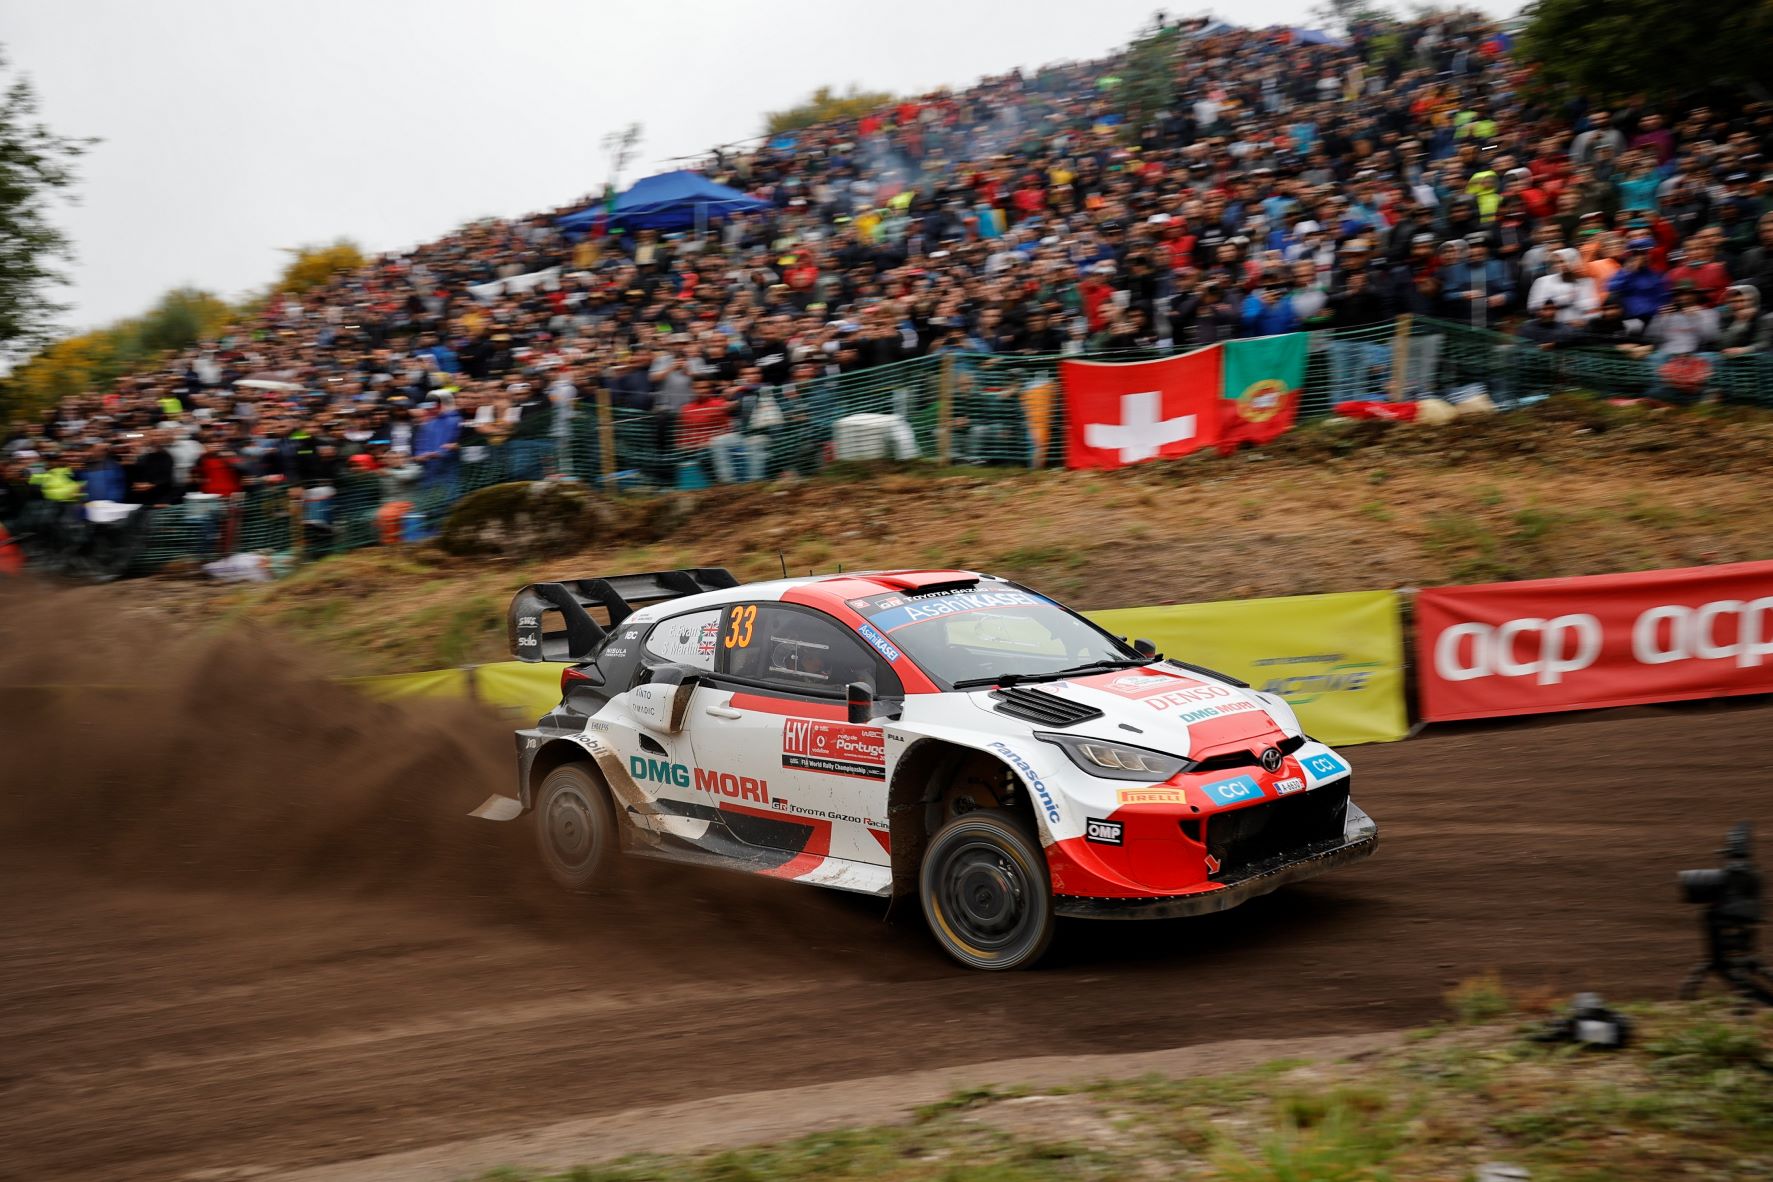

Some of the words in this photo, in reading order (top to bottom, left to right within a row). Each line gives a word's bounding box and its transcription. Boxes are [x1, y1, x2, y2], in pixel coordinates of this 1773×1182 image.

[904, 590, 950, 603] TOYOTA
[904, 591, 1039, 621] AsahiKASEI
[725, 604, 757, 648] 33
[860, 624, 899, 661] AsahiKASEI
[1434, 613, 1603, 686] acp
[1144, 685, 1231, 711] DENSO
[1179, 706, 1219, 723] DMG
[1219, 701, 1256, 714] MORI
[785, 721, 808, 752] HY
[836, 739, 885, 756] Portuga
[887, 733, 905, 742] PIAA
[809, 760, 822, 769] World
[822, 762, 834, 771] Rally
[834, 763, 866, 774] Championship
[1312, 757, 1335, 773] CCI
[630, 755, 690, 788] DMG
[694, 767, 769, 804] MORI
[987, 741, 1060, 824] Panasonic
[1218, 781, 1250, 798] CCI
[1122, 790, 1181, 802] PIRELLI
[772, 801, 788, 811] GR
[790, 804, 826, 817] TOYOTA
[827, 810, 862, 824] GAZOO
[863, 817, 889, 829] Racin
[1088, 823, 1121, 840] OMP
